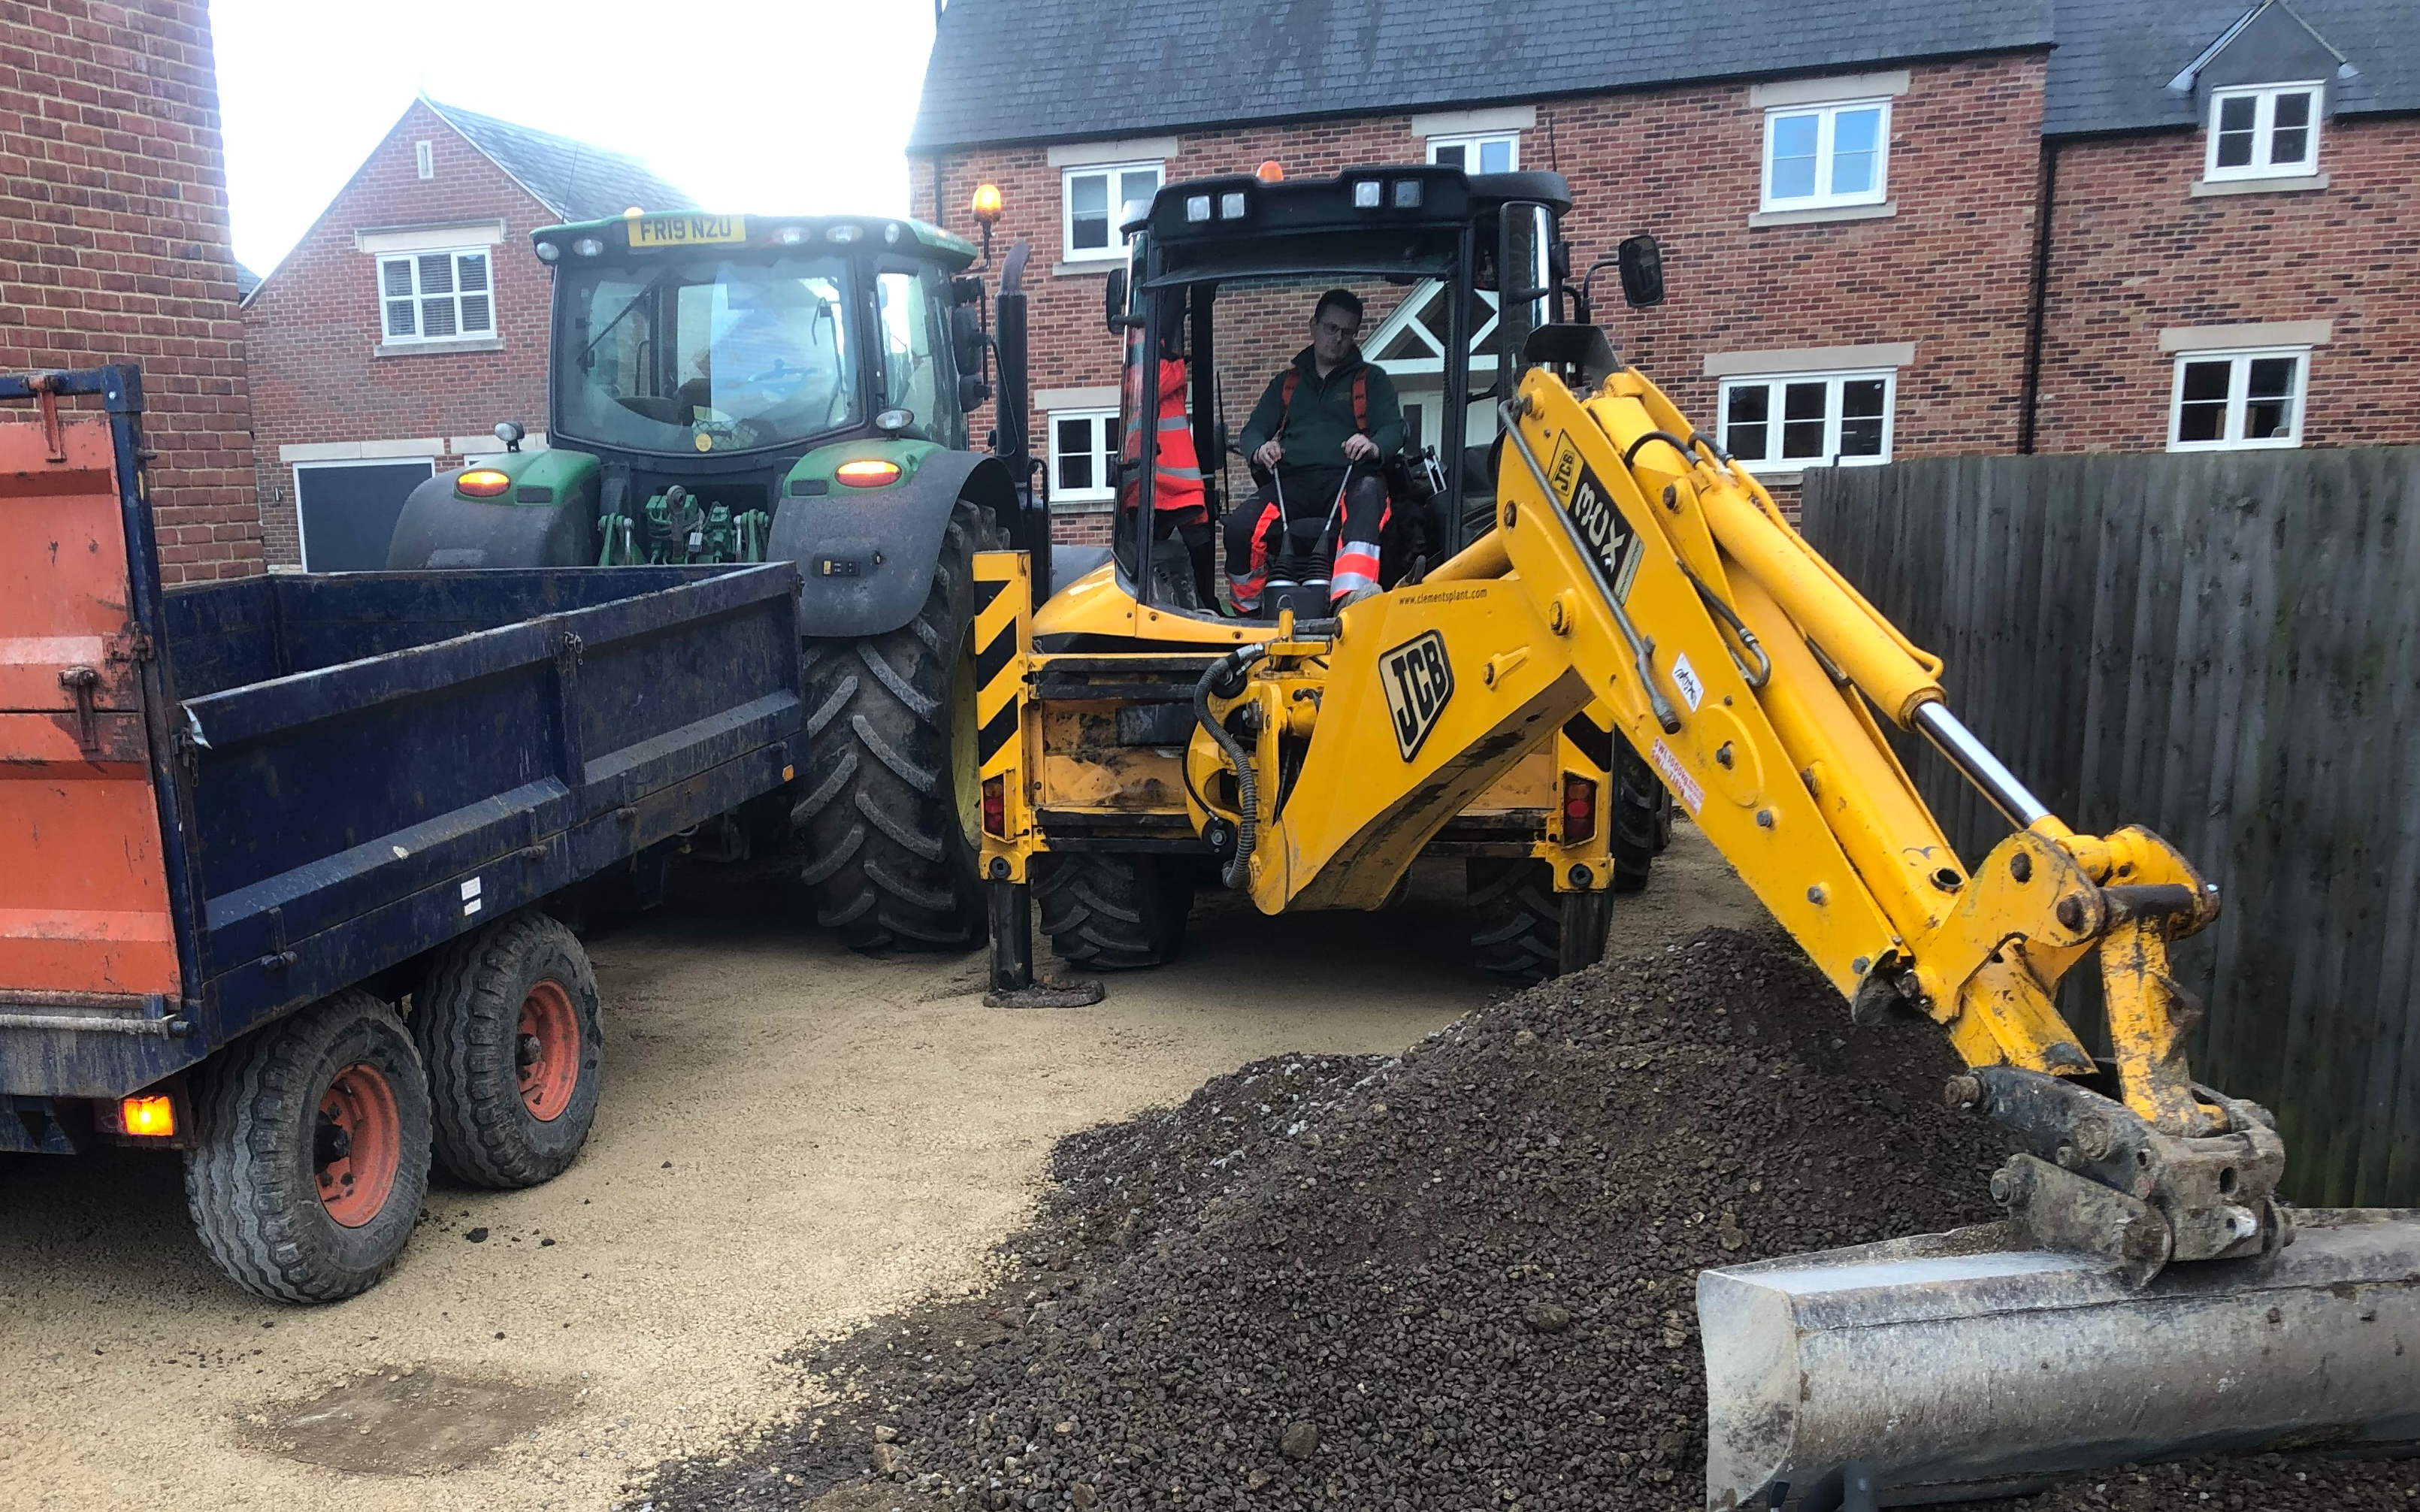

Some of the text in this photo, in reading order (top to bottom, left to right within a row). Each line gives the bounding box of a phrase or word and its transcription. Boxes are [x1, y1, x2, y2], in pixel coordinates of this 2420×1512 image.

[640, 215, 731, 241] FR19 NZU
[1554, 452, 1574, 491] JCB
[1399, 588, 1487, 605] www.clementsplant.com
[1390, 640, 1447, 746] JCB
